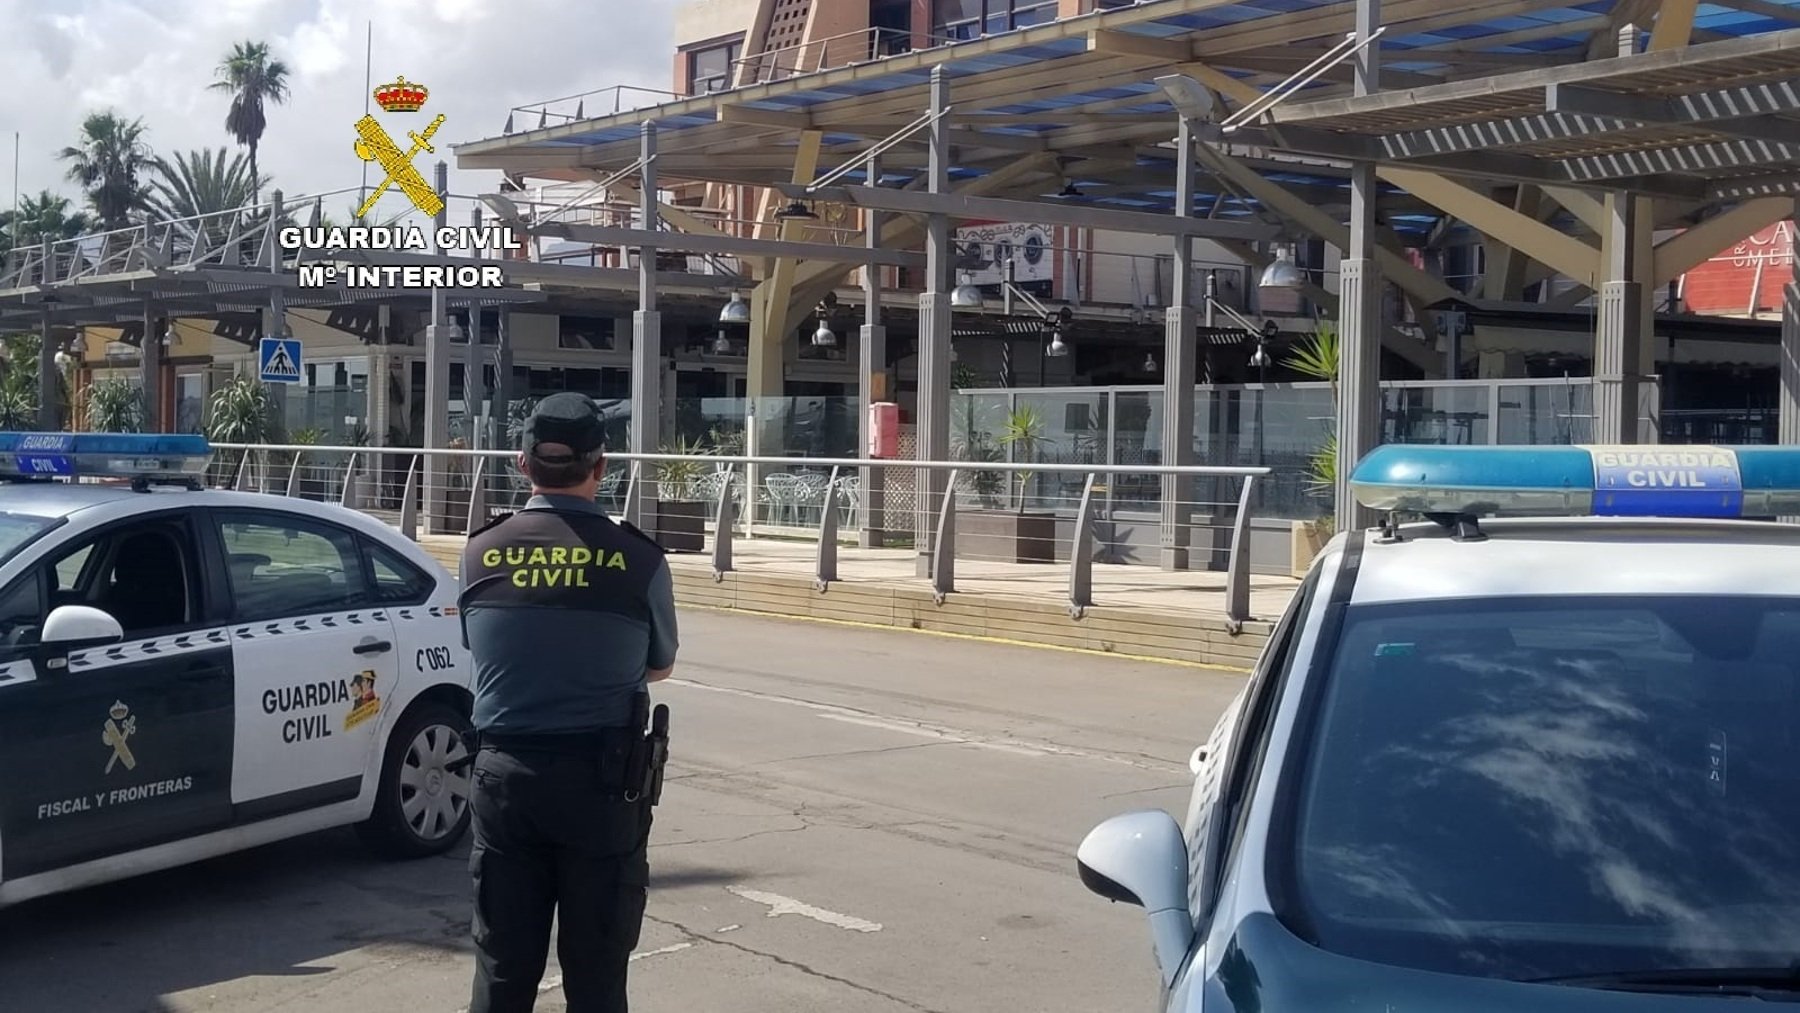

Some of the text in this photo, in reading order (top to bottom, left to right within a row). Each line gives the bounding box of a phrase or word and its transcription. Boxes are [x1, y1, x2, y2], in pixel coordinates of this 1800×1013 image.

[23, 435, 64, 449] GUARDIA
[31, 458, 58, 473] CIVIL
[1600, 453, 1732, 468] GUARDIA
[1627, 470, 1706, 487] CIVIL
[482, 546, 627, 571] GUARDIA
[512, 568, 590, 588] CIVIL
[426, 646, 455, 671] 062
[262, 679, 350, 715] GUARDIA
[282, 714, 332, 744] CIVIL
[37, 776, 193, 820] FISCAL Y FRONTERAS
